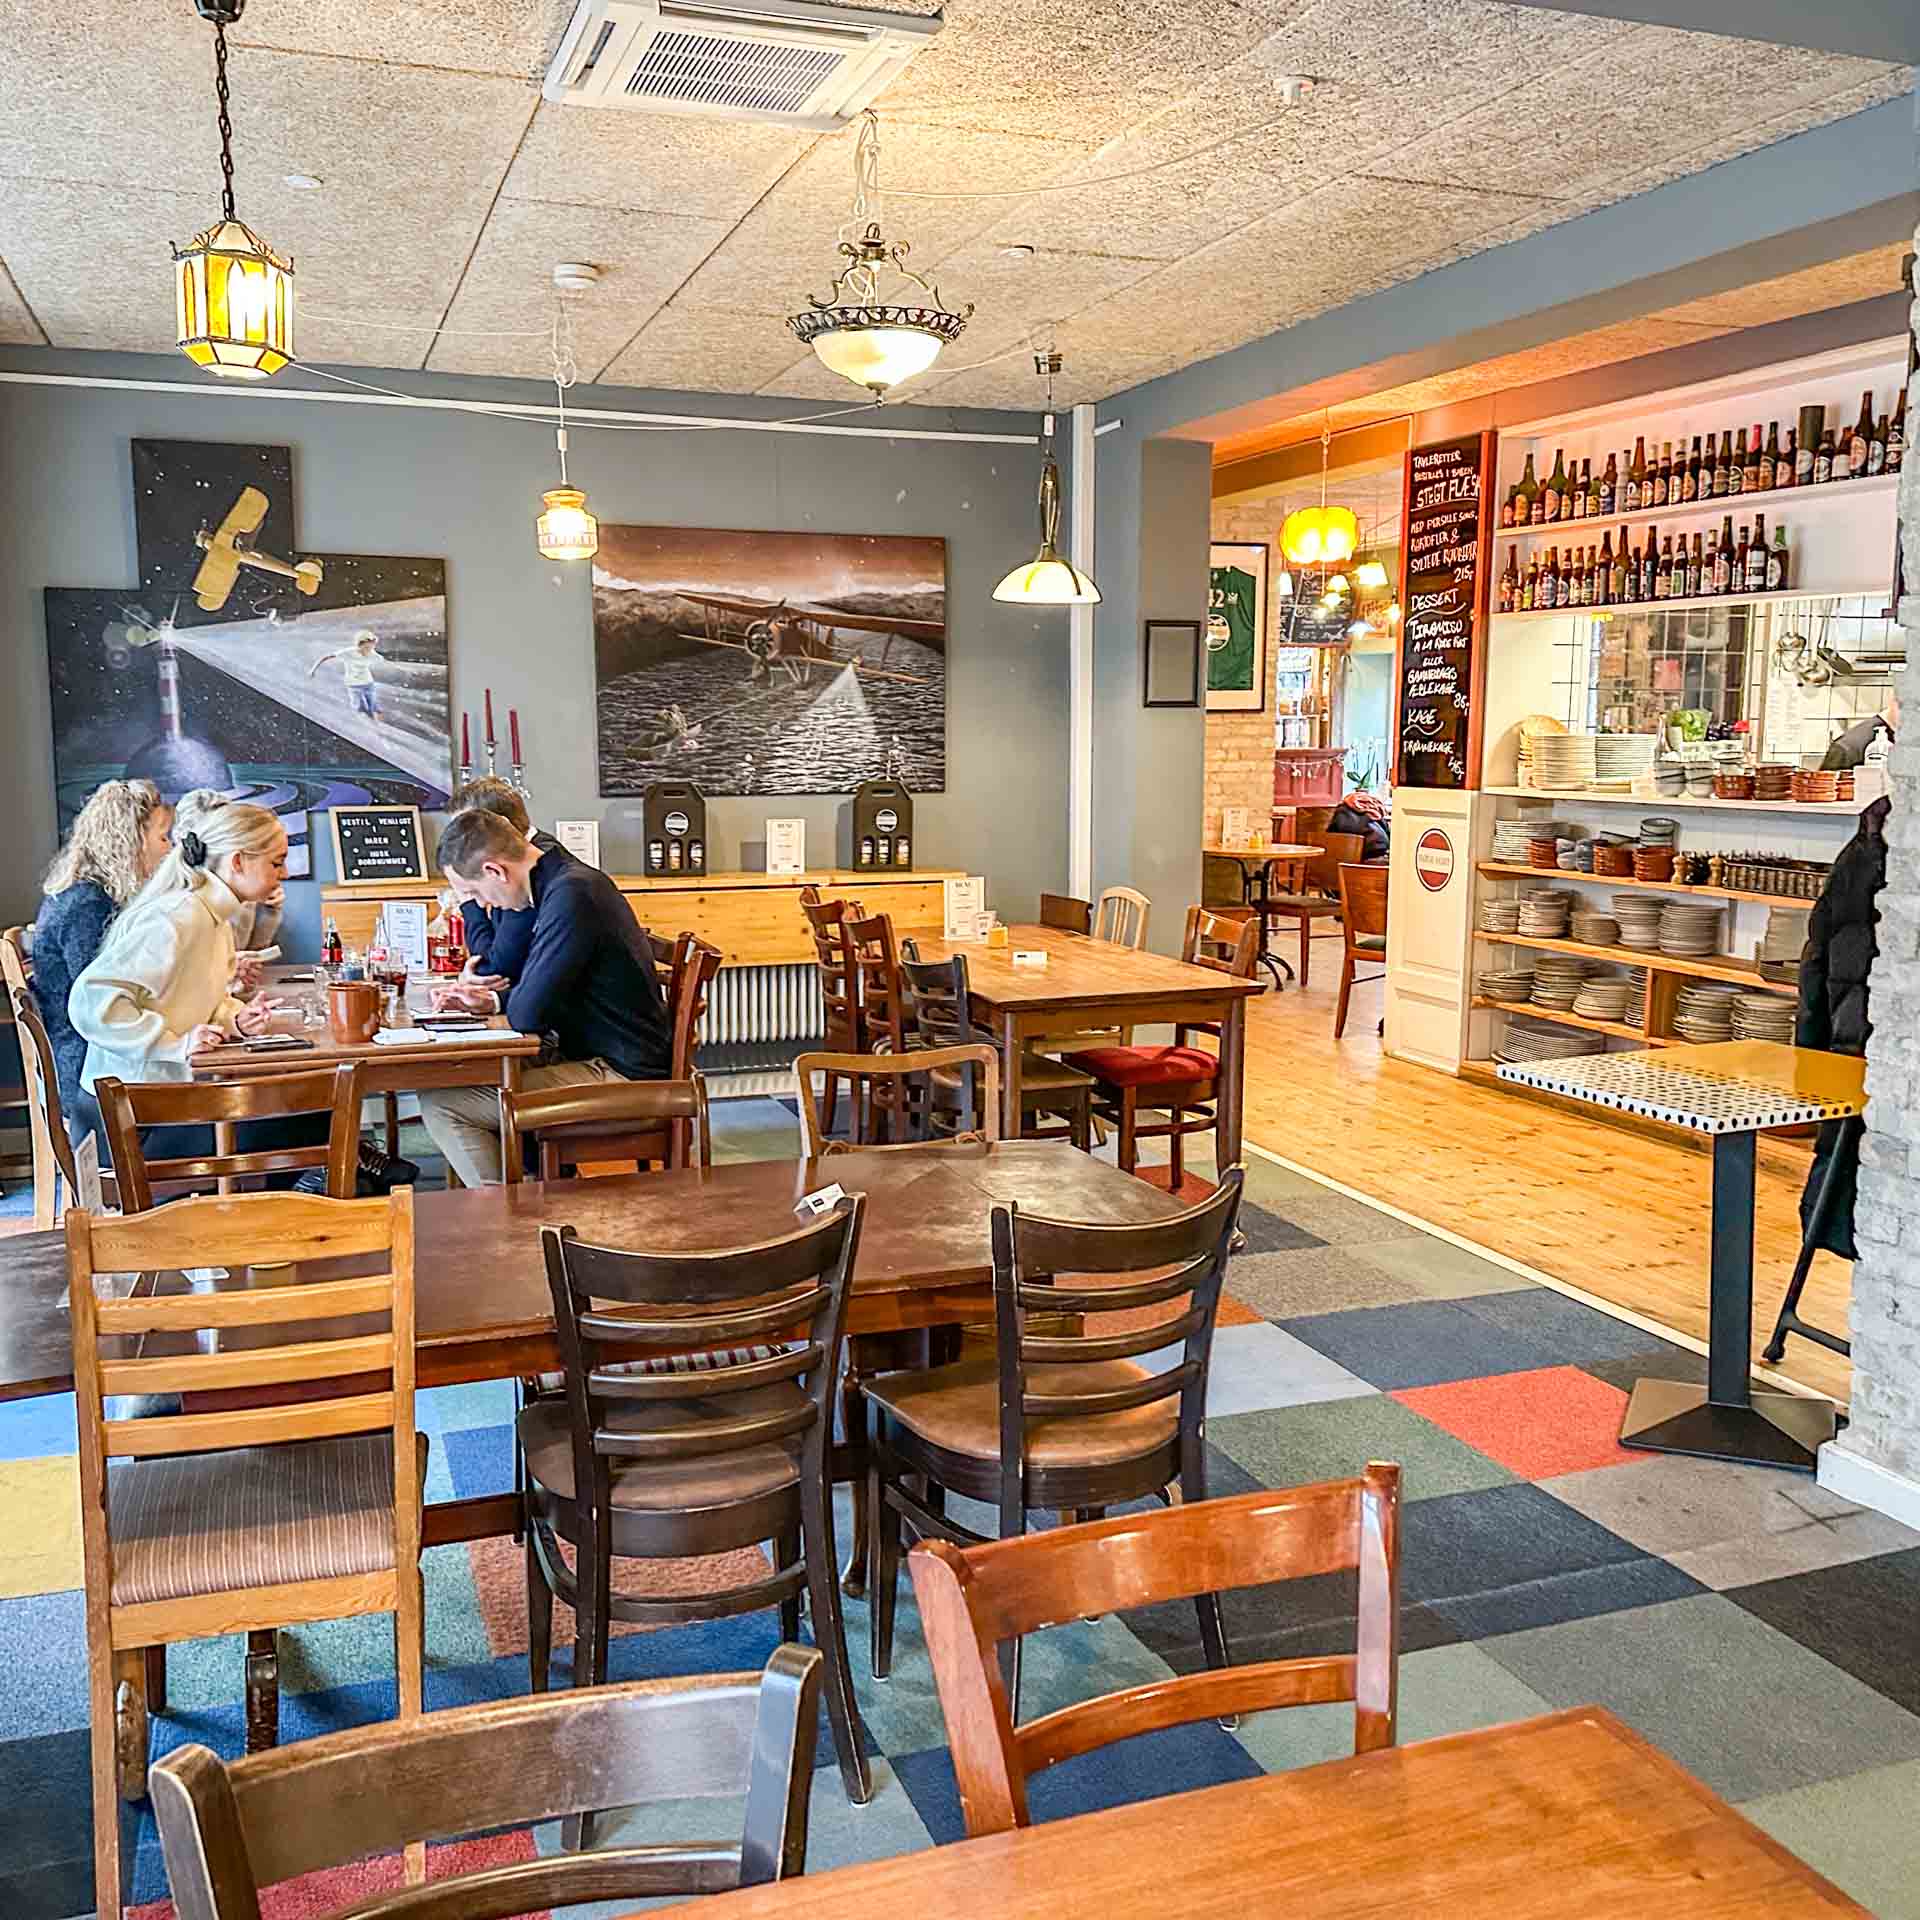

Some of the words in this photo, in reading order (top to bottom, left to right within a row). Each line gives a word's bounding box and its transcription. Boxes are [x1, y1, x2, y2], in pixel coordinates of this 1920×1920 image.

[1416, 481, 1447, 508] STEGT
[1427, 512, 1458, 531] PERSILLE
[1411, 535, 1449, 553] KARTOFLER
[1450, 528, 1461, 545] &
[1411, 551, 1441, 573] SYLTEDE
[1411, 588, 1459, 611] DESSERT
[1422, 639, 1433, 651] LA
[1408, 682, 1456, 697] ÆBLEKAGE
[1408, 708, 1438, 725] KAGE
